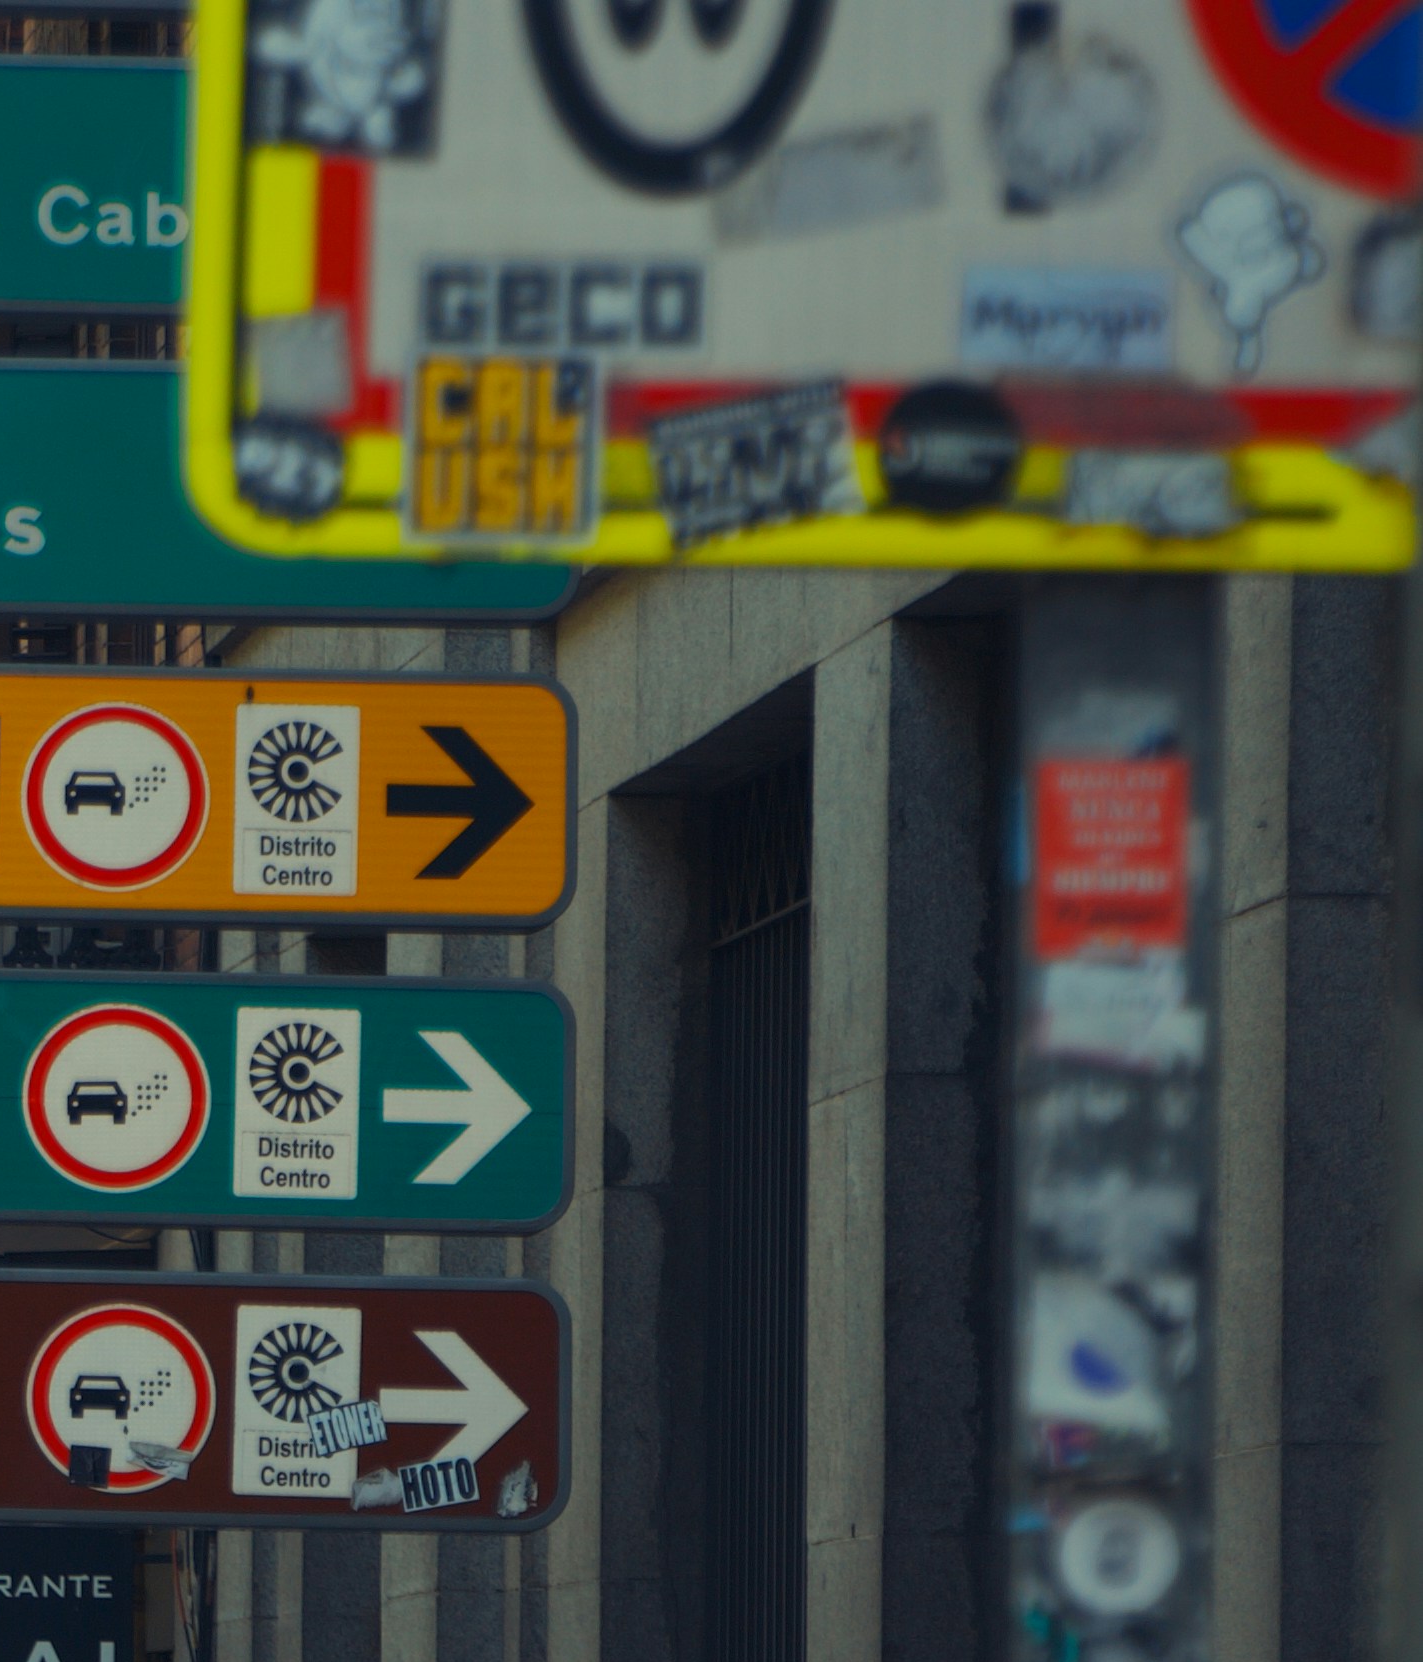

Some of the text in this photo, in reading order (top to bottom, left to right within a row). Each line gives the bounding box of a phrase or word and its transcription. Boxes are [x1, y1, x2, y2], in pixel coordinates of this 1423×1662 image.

[259, 834, 337, 858] Distrito
[261, 864, 333, 887] Centro
[258, 1136, 335, 1160] Distrito
[259, 1166, 331, 1190] Centro
[258, 1435, 333, 1459] Distri
[260, 1466, 331, 1489] Centro
[400, 1458, 477, 1510] HOTO
